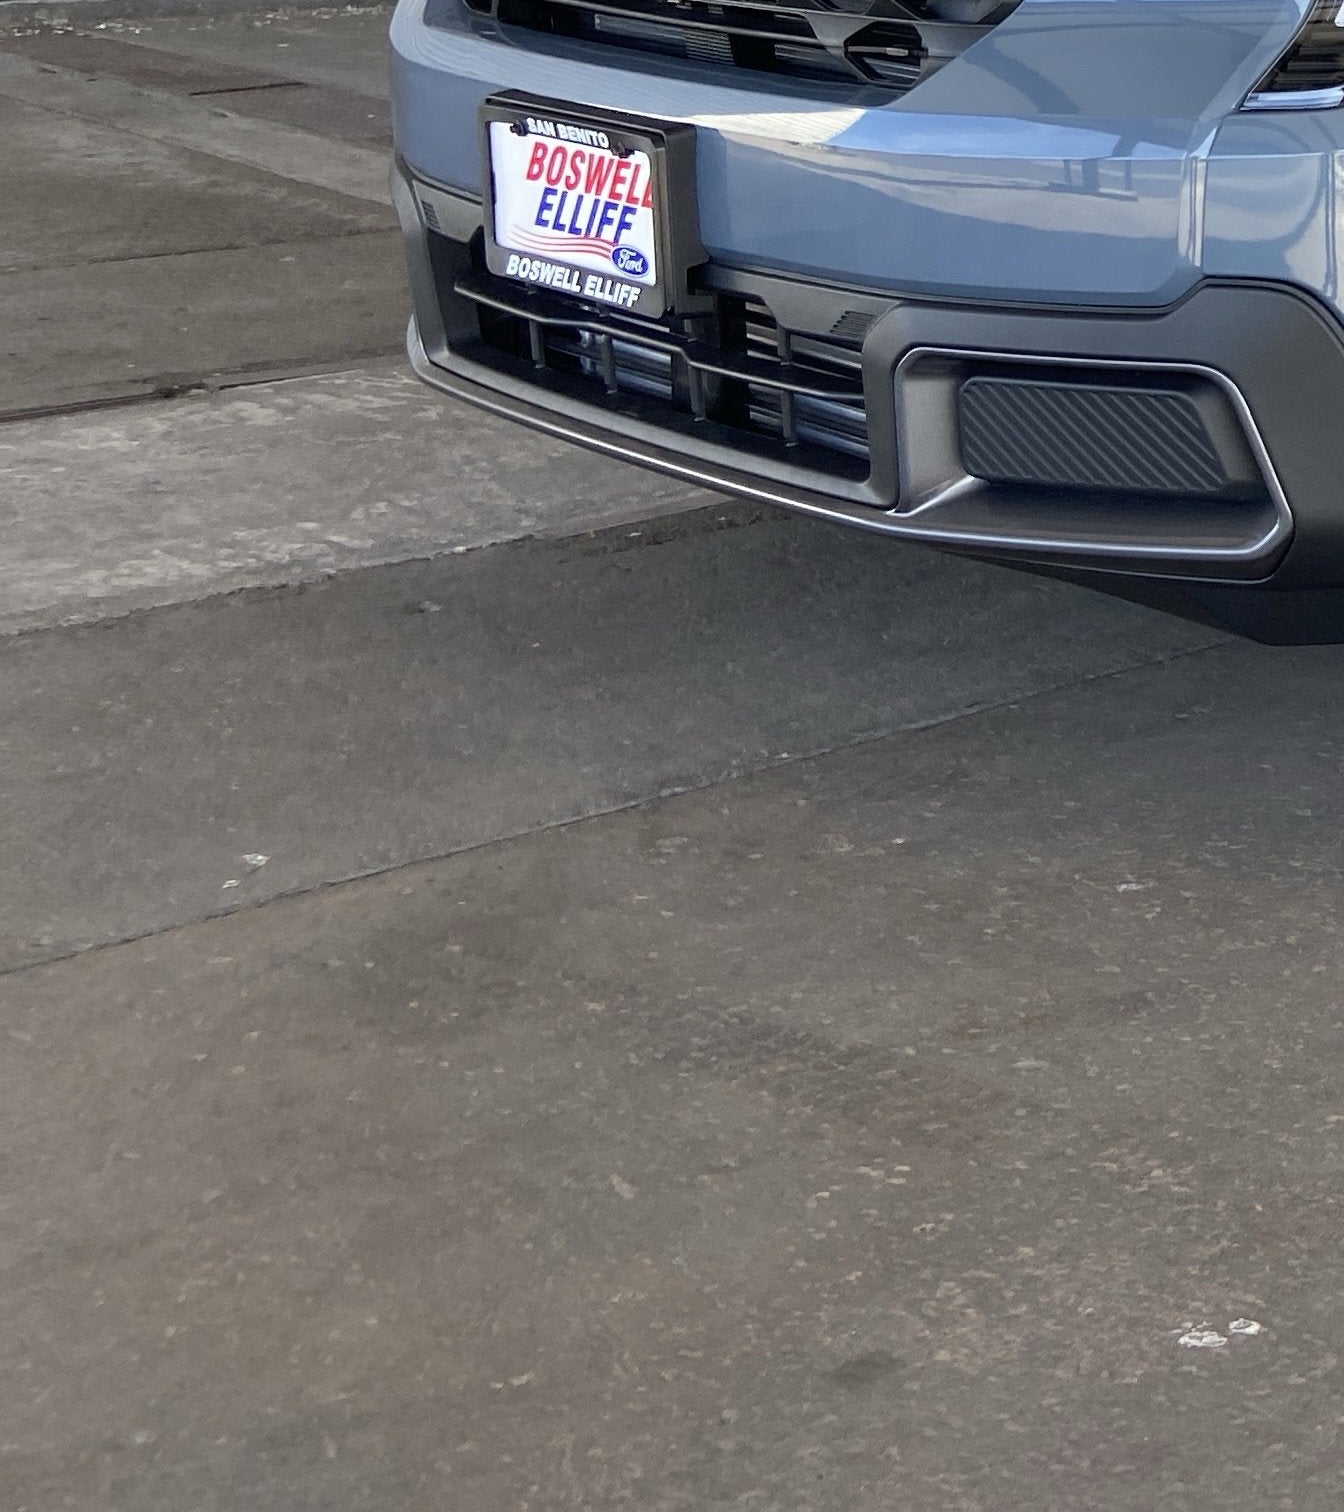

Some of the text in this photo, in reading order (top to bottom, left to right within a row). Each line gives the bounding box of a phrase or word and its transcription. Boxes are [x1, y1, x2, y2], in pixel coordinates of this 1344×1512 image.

[526, 117, 610, 149] SAN BENITO
[534, 186, 638, 245] ELLIFF
[505, 254, 642, 308] BOSWELL ELLIFF
[618, 249, 644, 273] Ford
